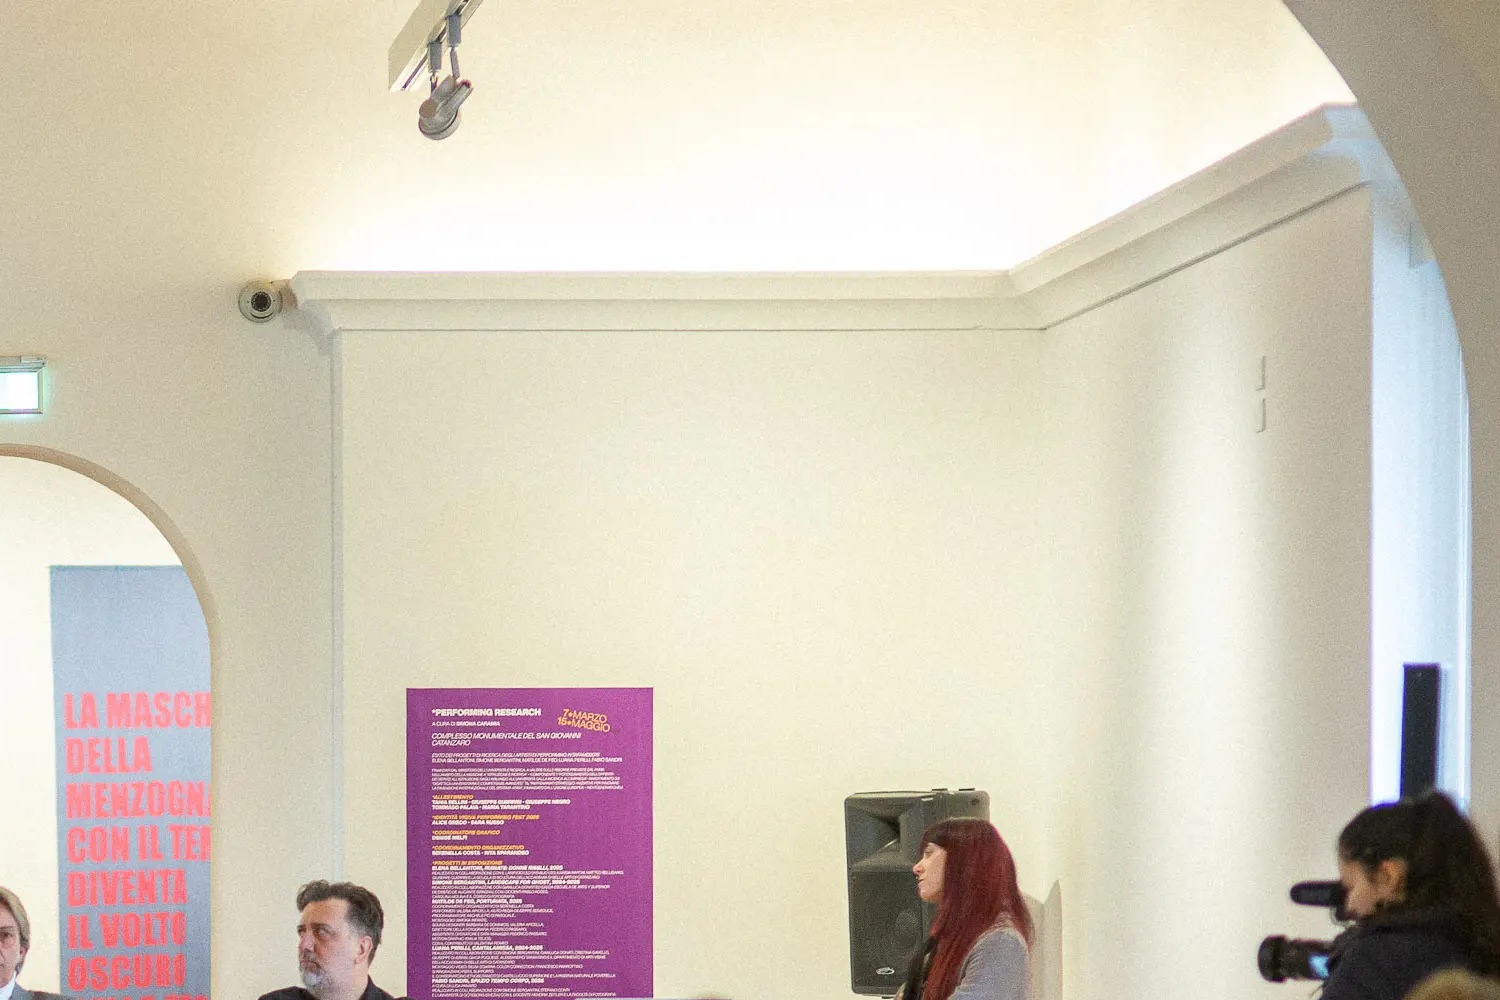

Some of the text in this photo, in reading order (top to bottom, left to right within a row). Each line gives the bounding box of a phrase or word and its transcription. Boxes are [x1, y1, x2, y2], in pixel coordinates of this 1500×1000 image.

[64, 691, 212, 729] LA MASCH
[65, 736, 152, 774] DELLA
[66, 780, 212, 819] MENZOGN
[67, 826, 130, 864] CON
[138, 825, 164, 861] IL
[68, 869, 188, 906] DIVENTA
[68, 911, 187, 949] IL VOLTO
[68, 953, 187, 991] OSCURO
